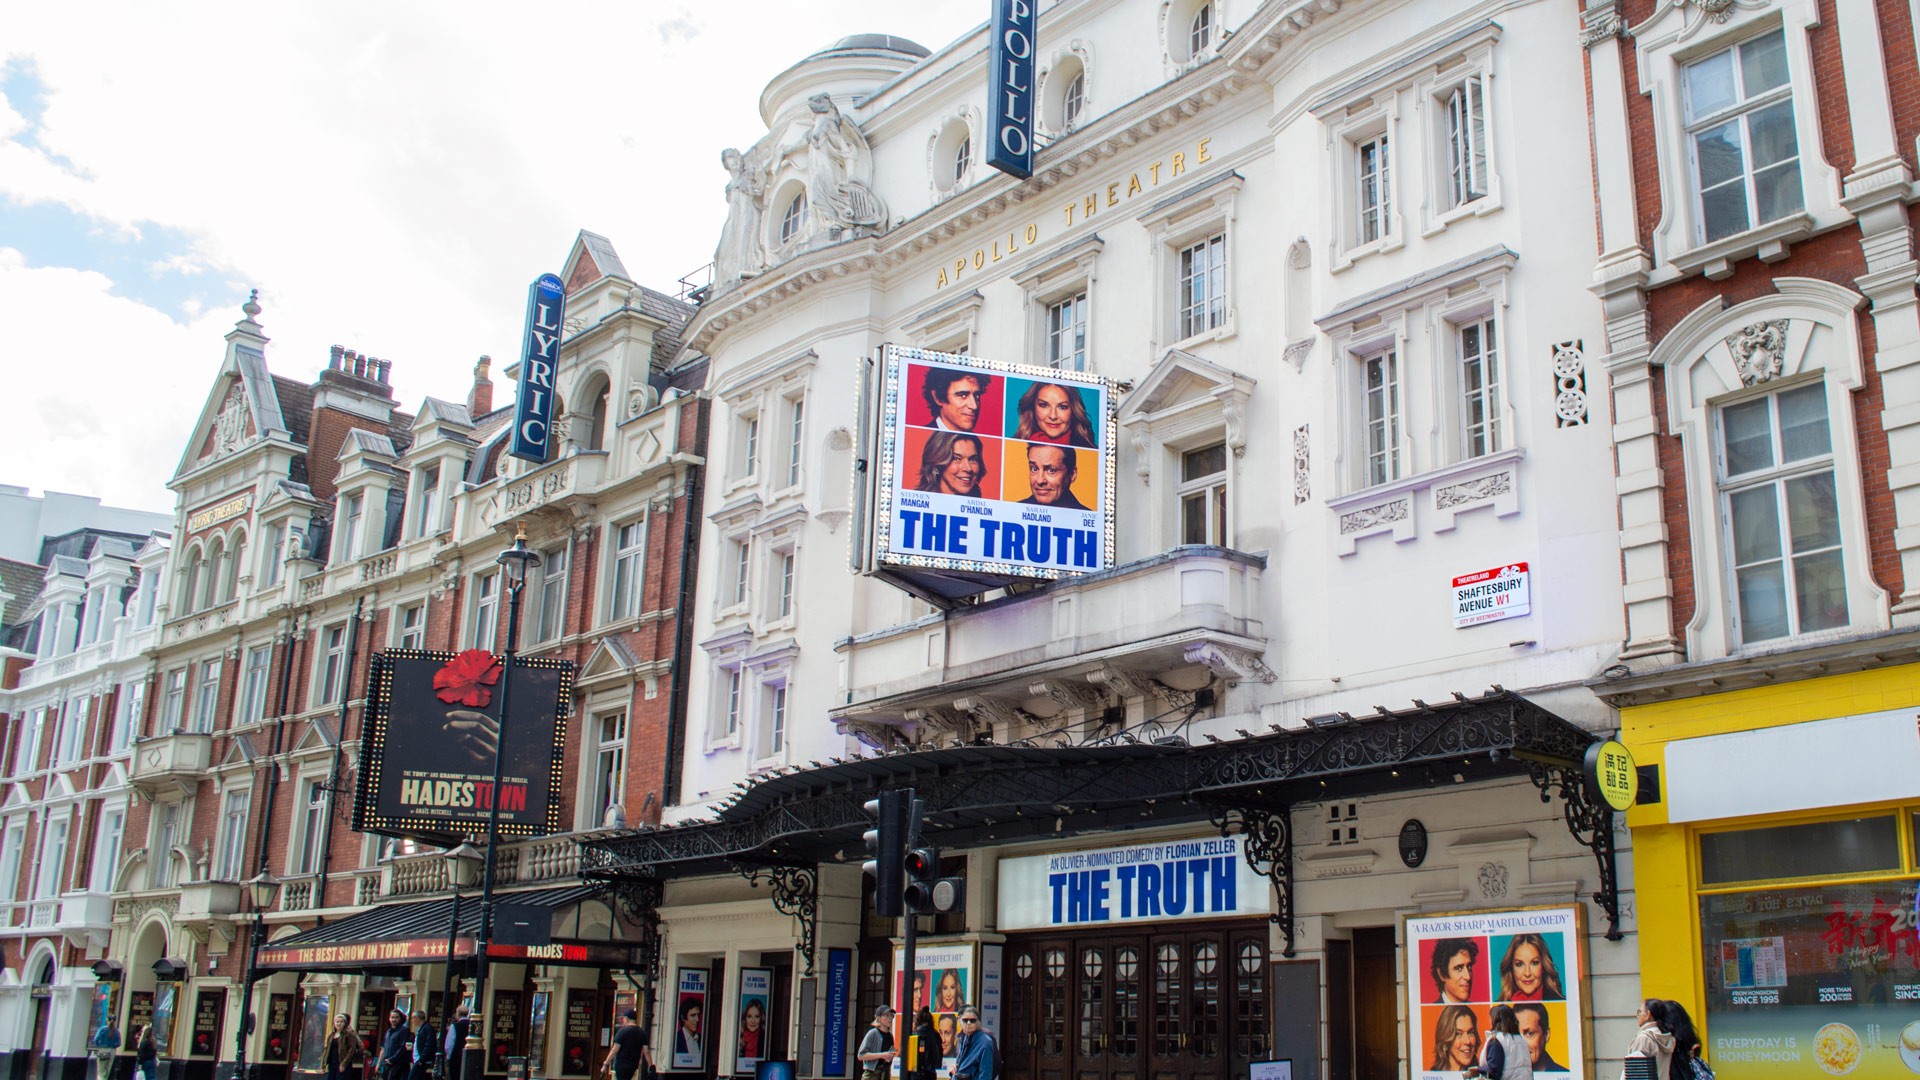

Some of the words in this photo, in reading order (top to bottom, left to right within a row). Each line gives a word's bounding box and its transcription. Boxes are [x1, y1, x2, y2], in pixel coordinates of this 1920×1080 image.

[936, 223, 1037, 289] APOLLO
[1064, 138, 1211, 226] THEATRE
[522, 303, 558, 445] LYRIC
[901, 491, 930, 499] STEPHEN
[901, 497, 930, 509] MANGAN
[960, 504, 993, 516] O'HANLON
[1026, 506, 1048, 514] SARAH
[1022, 512, 1051, 523] HADLAND
[1083, 518, 1095, 528] DEE
[900, 510, 969, 555] THE
[980, 519, 1098, 569] TRUTH
[1457, 572, 1490, 585] THEATRELAND
[1458, 578, 1522, 601] SHAFTESBURY
[1459, 597, 1493, 614] AVENUE
[1496, 594, 1510, 606] W1
[1476, 611, 1505, 621] WESTMINSTER
[1050, 858, 1060, 871] AN
[1060, 850, 1125, 871] OLIVIER-NOMINATED
[1126, 848, 1155, 864] COMEDY
[1155, 846, 1164, 861] BY
[1165, 842, 1201, 859] FLORIAN
[1203, 839, 1236, 856] ZELLER
[1049, 868, 1110, 924] THE
[1117, 856, 1237, 918] TRUTH
[1422, 920, 1485, 934] RAZOR-SHARP
[1488, 917, 1528, 930] MARITAL
[315, 947, 337, 962] BEST
[338, 945, 365, 961] SHOW
[366, 943, 378, 960] IN
[527, 943, 587, 961] HADESTOWN
[1850, 944, 1880, 956] Happy
[1849, 959, 1869, 970] New
[1872, 952, 1893, 964] Year
[687, 973, 700, 982] THE
[681, 981, 704, 991] TRUTH
[1732, 996, 1759, 1004] SINCE
[1760, 995, 1780, 1004] 1995
[1819, 993, 1837, 1002] 200
[830, 961, 844, 1065] TheTruthPlay.com
[1717, 1037, 1782, 1050] EVERYDAY
[1785, 1037, 1797, 1048] IS
[1718, 1051, 1800, 1063] HONEYMOON
